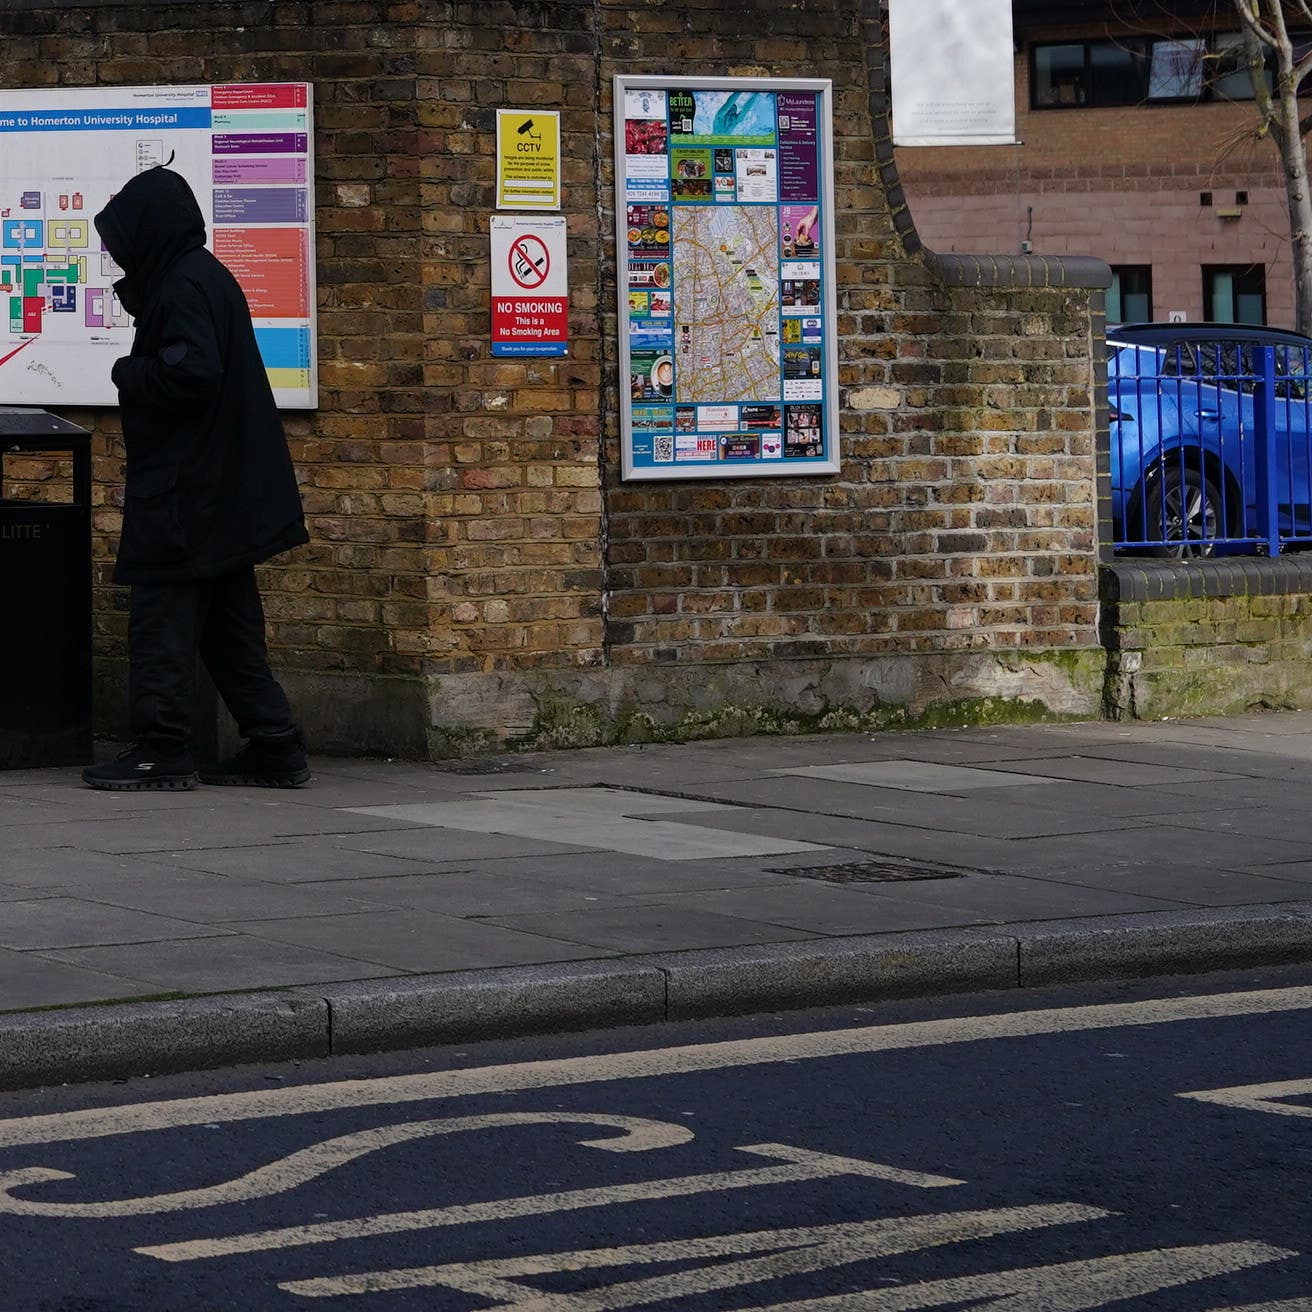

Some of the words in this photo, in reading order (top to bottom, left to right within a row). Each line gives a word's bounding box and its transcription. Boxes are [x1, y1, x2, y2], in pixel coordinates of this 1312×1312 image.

[670, 97, 692, 106] BETTER
[18, 117, 28, 126] to
[31, 117, 80, 126] Homerton
[84, 115, 132, 126] University
[136, 114, 177, 125] Hospital
[517, 143, 541, 152] CCTV
[498, 303, 512, 313] NO
[515, 303, 562, 313] SMOKING
[512, 328, 542, 337] Smoking
[543, 328, 559, 336] Area
[697, 441, 716, 450] HERE
[2, 521, 50, 539] LITTE
